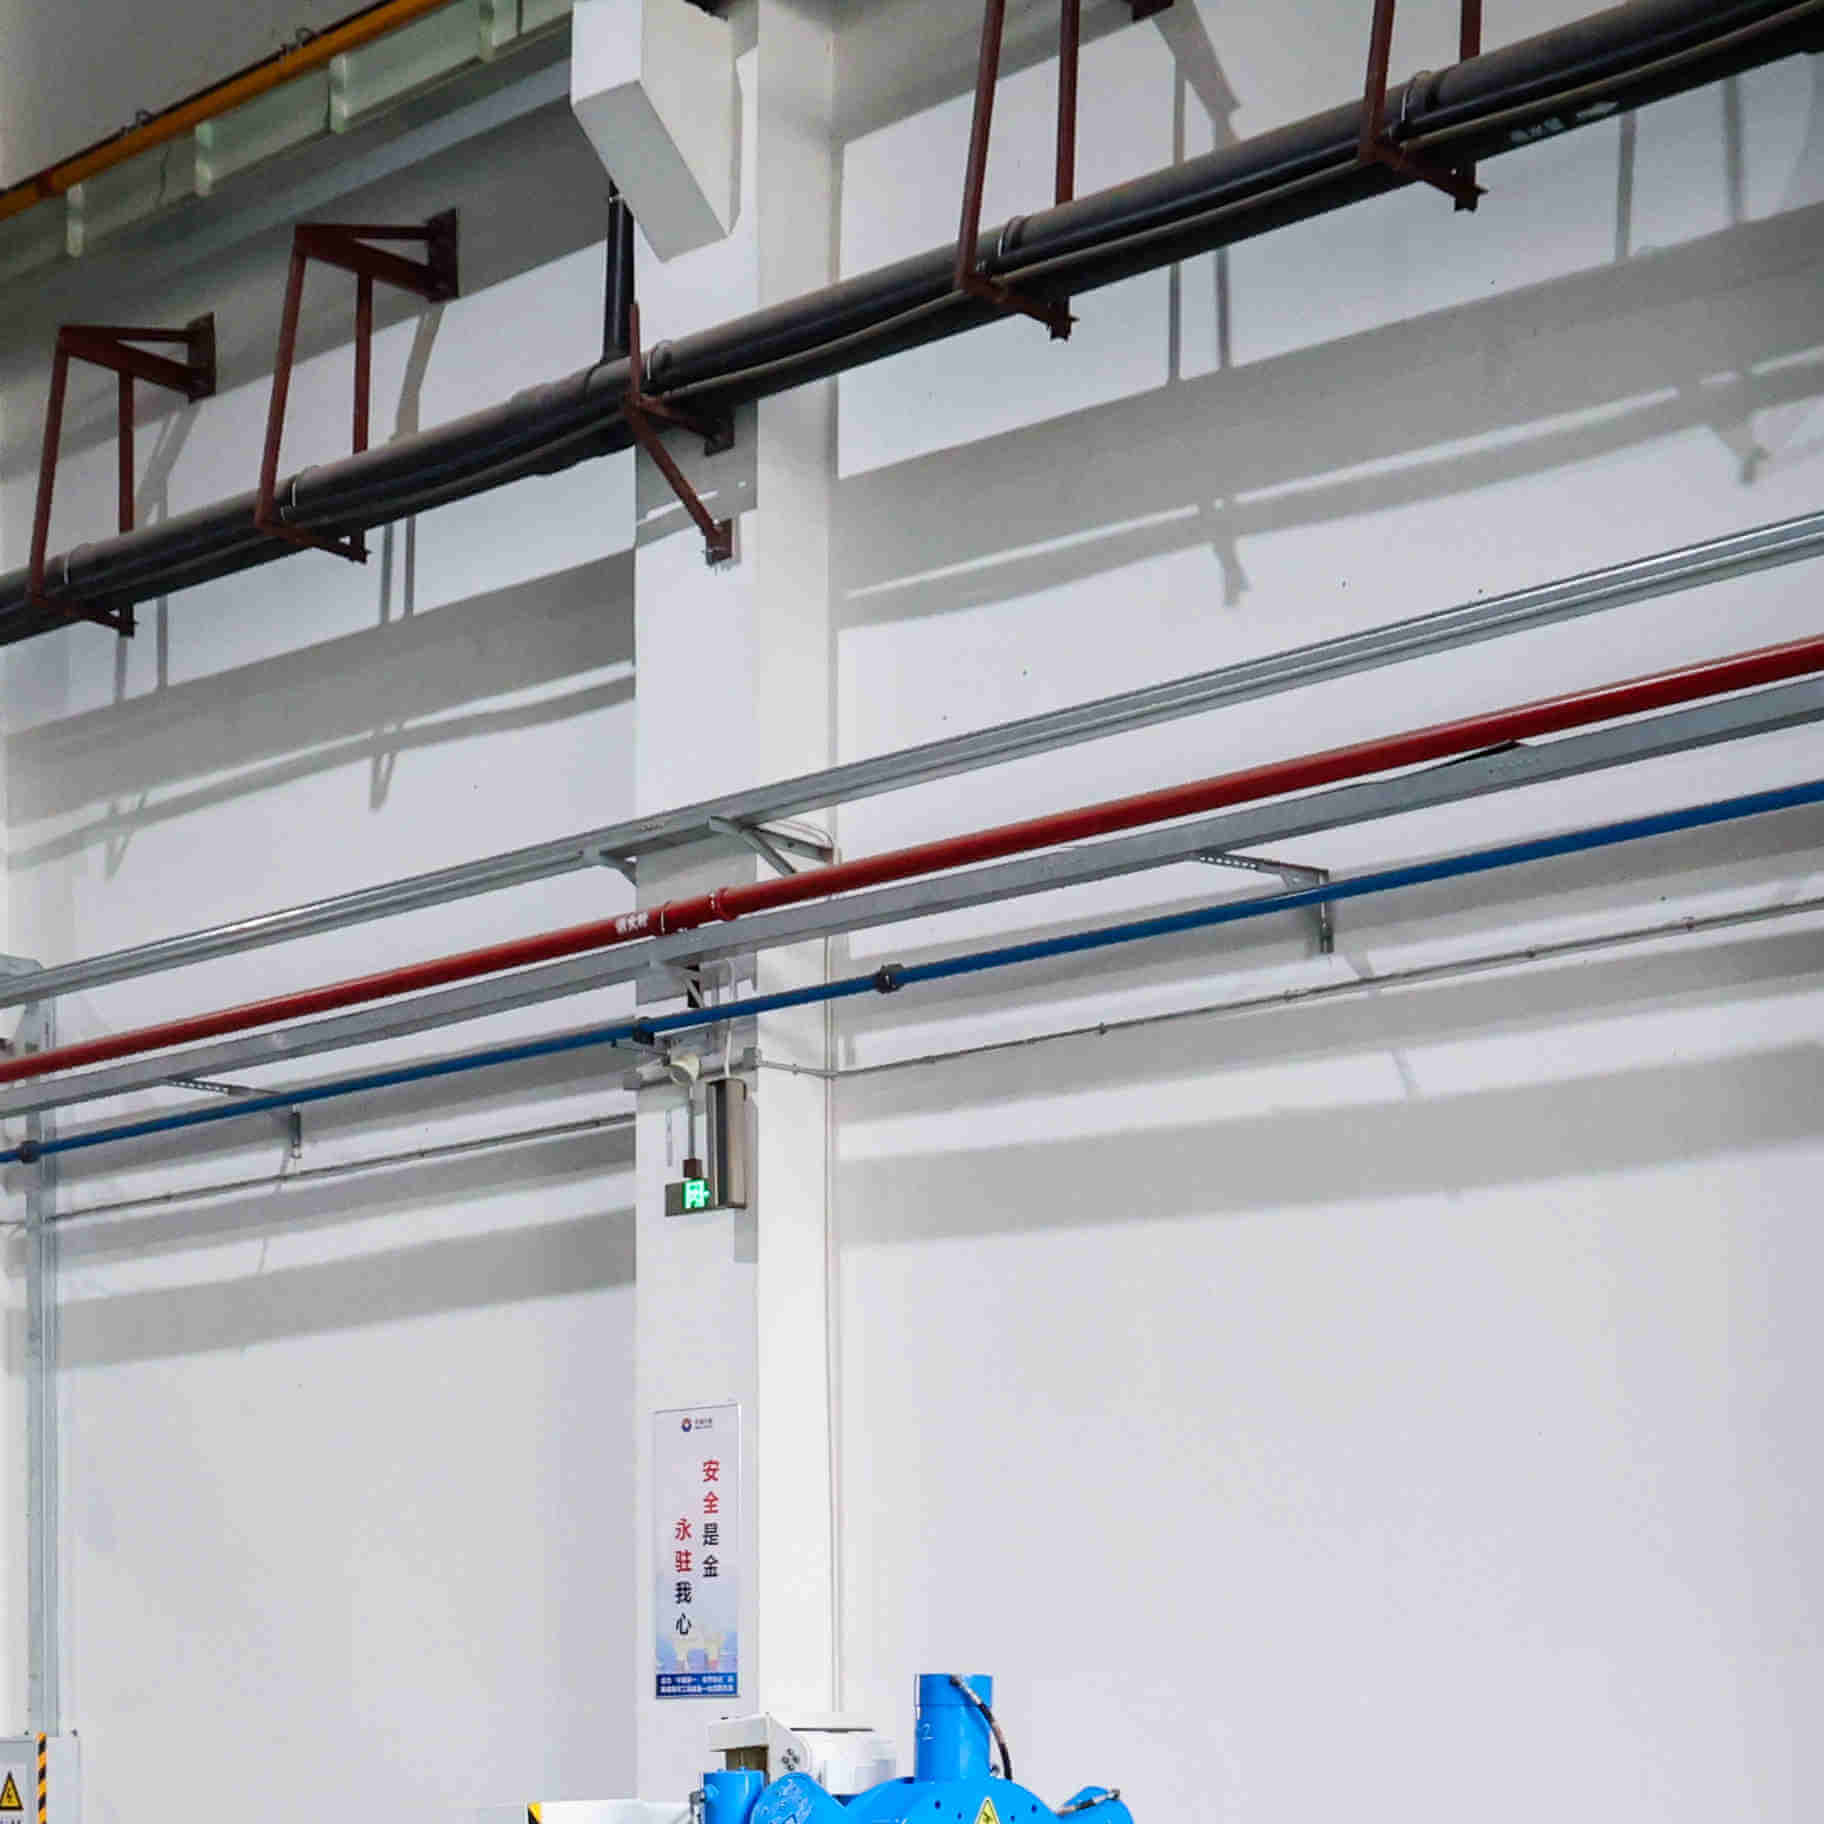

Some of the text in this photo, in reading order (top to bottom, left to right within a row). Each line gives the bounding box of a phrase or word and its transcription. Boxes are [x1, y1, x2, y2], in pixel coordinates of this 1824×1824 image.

[674, 1518, 693, 1636] 永驻我心
[702, 1459, 720, 1578] 安全是金
